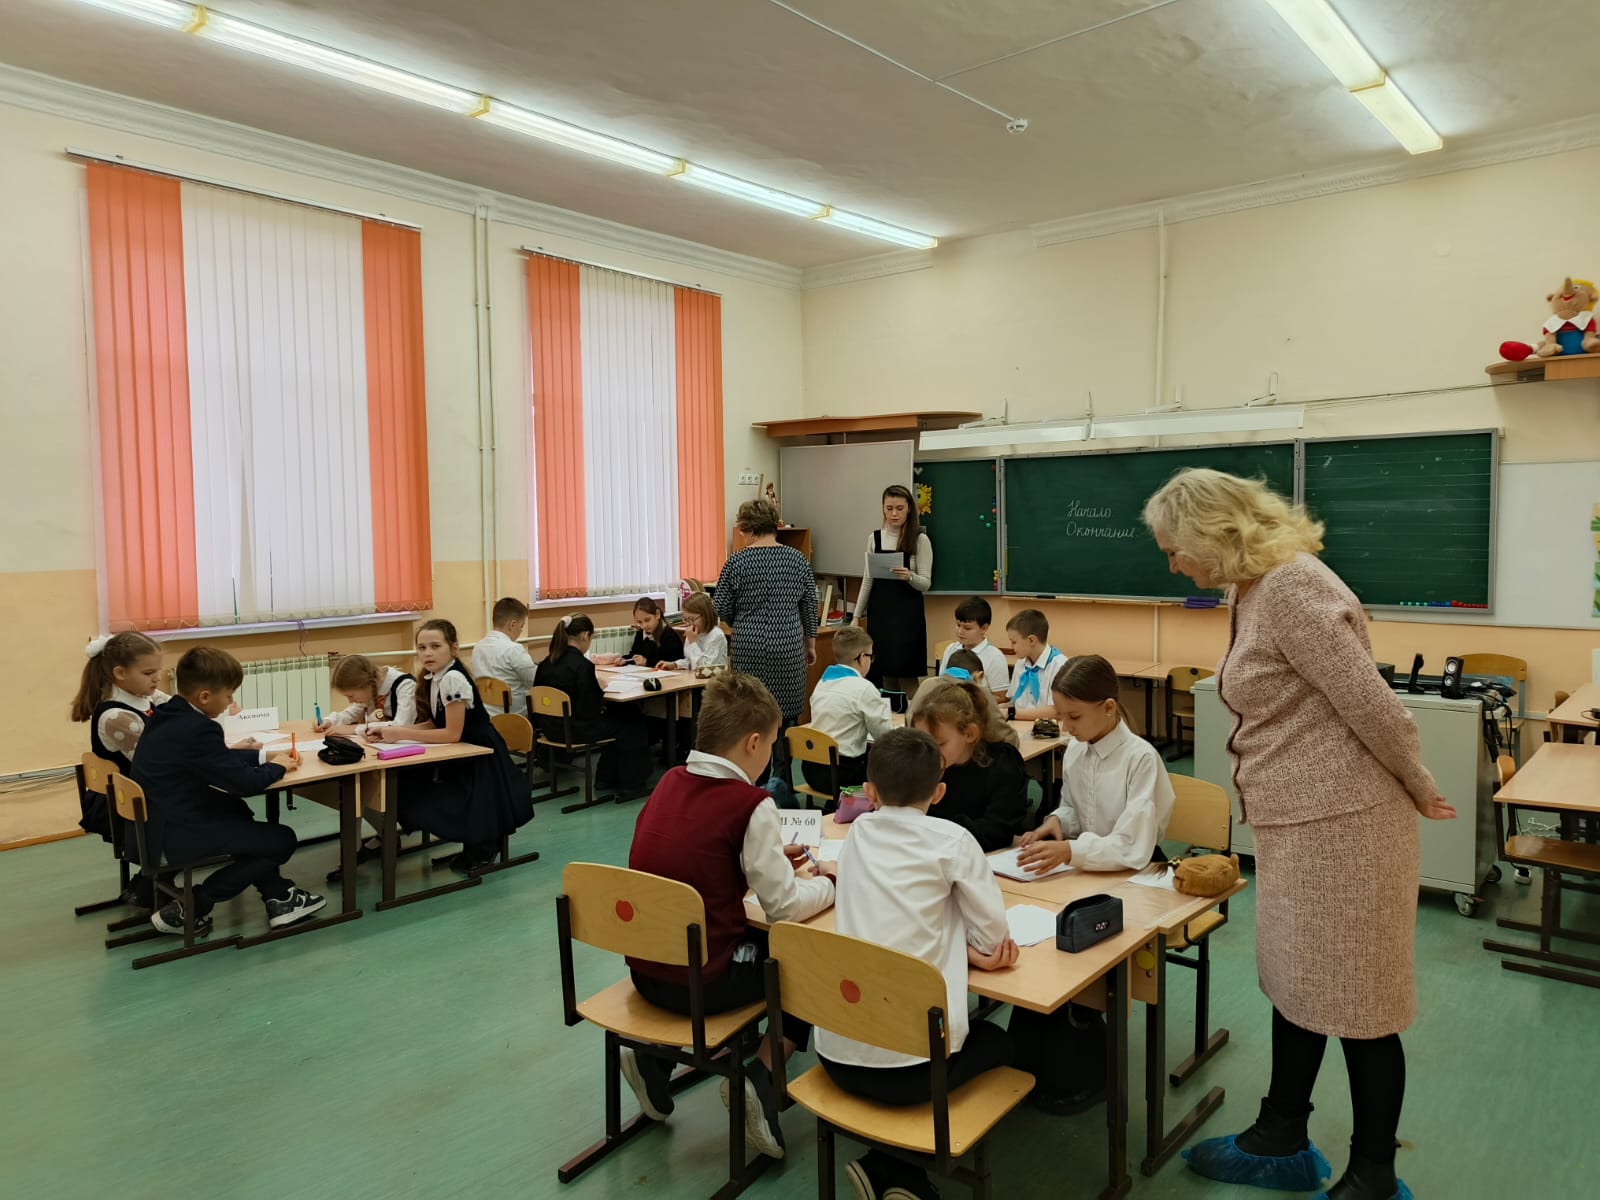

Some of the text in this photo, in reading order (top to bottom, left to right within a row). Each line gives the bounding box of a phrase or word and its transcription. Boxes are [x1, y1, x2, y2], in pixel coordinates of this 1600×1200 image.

[1067, 499, 1112, 518] Начало
[1066, 520, 1136, 539] Окончание
[804, 817, 816, 826] 60
